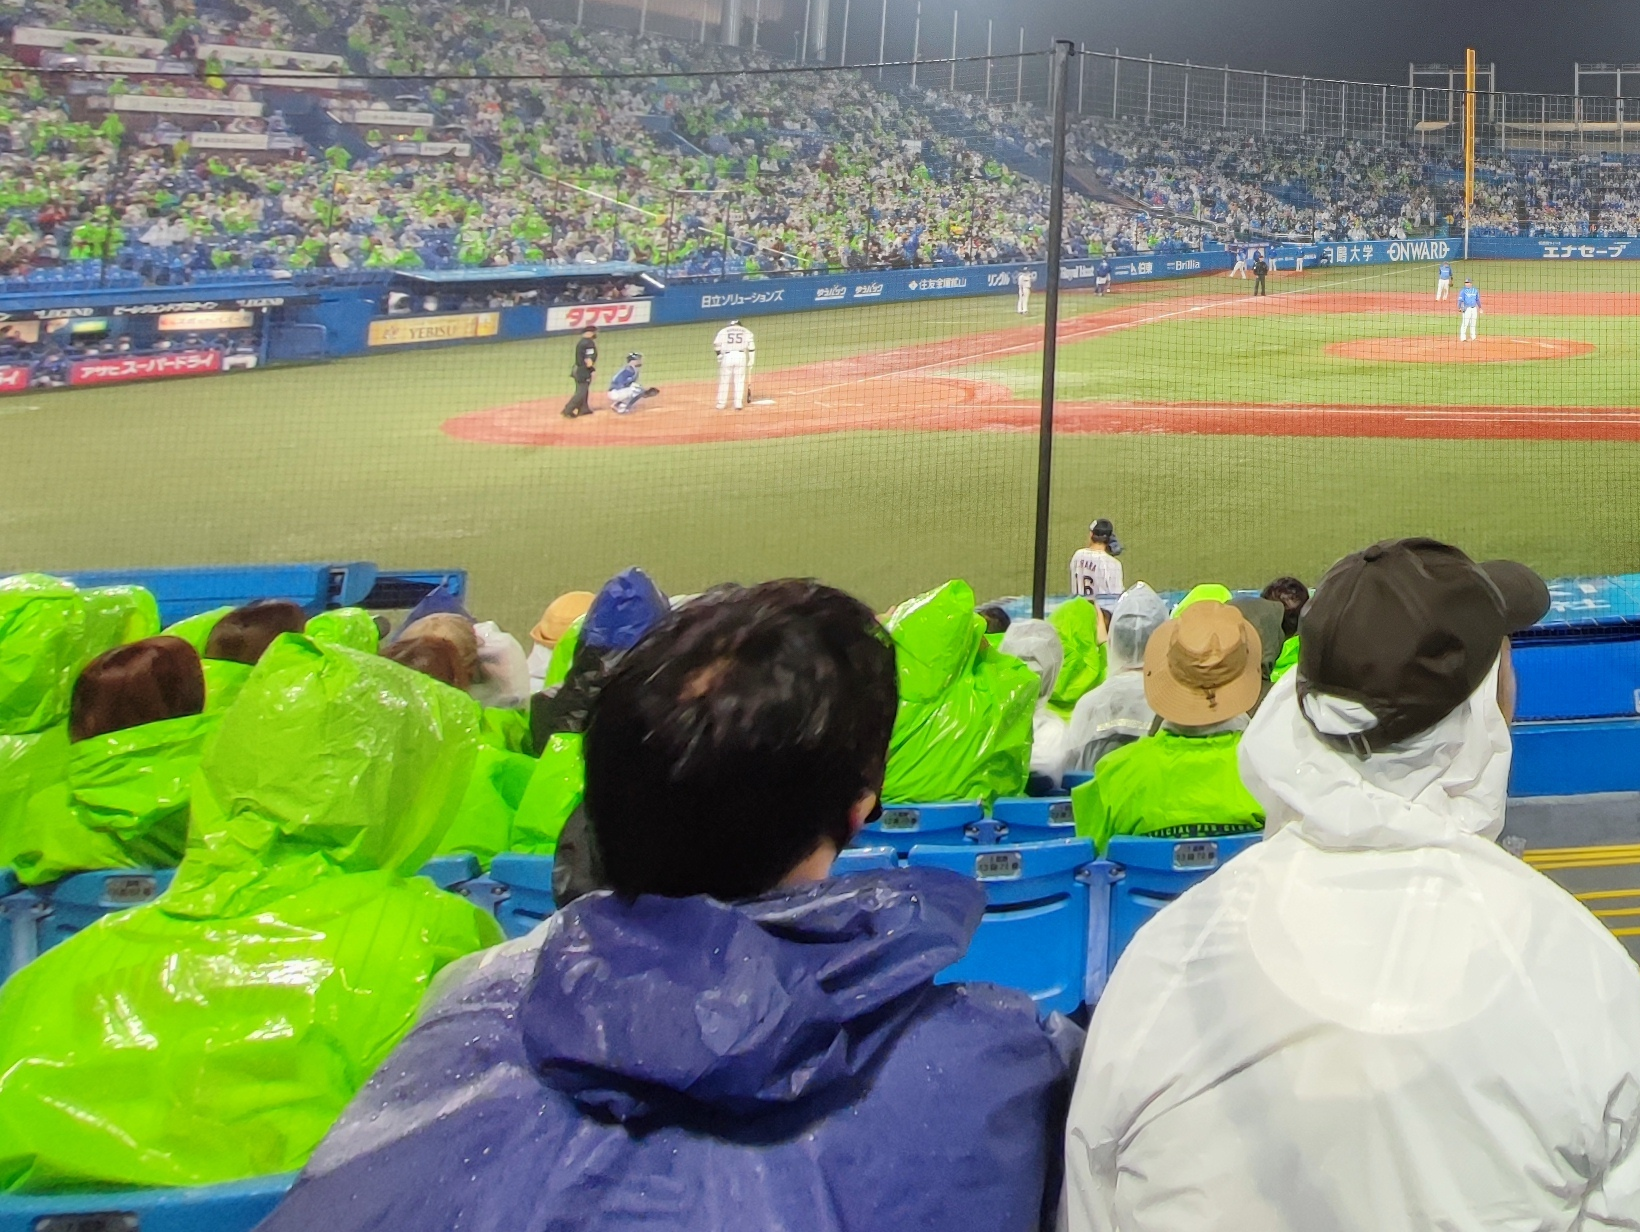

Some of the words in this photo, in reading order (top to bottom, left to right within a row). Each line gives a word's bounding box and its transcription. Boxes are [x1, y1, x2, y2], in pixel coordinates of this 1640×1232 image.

[1387, 240, 1450, 261] ONWARD
[1542, 244, 1627, 258] エナセーブ
[1175, 259, 1200, 271] Brillia
[816, 283, 847, 297] ゆうパック
[855, 281, 884, 295] ゆうパック
[918, 276, 967, 291] 住友金属鉱山
[701, 289, 783, 309] 日立ソリューションズ
[565, 304, 635, 325] タフマン
[409, 325, 456, 340] YEBISU
[727, 332, 744, 344] 55
[80, 353, 215, 379] アサヒスーパードライ
